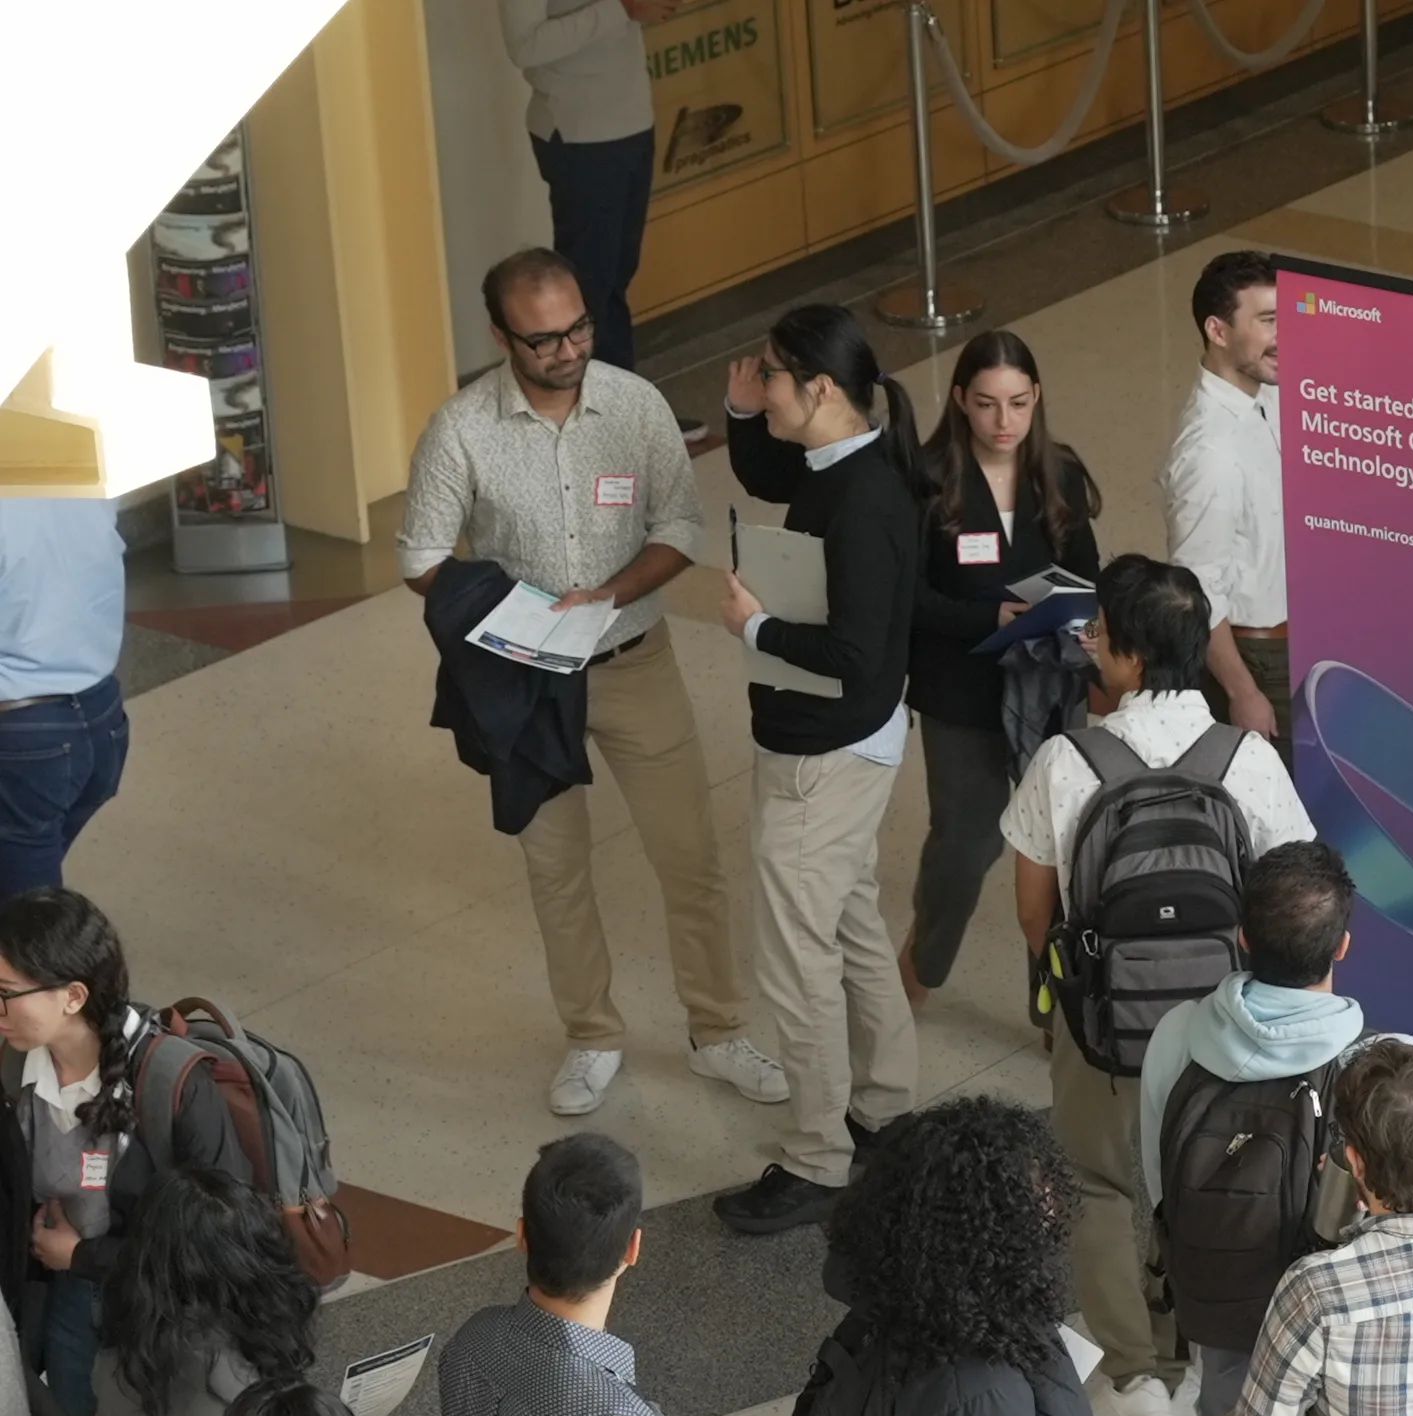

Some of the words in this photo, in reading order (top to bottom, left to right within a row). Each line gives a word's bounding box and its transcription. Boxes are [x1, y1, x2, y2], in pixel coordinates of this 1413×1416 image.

[1318, 298, 1383, 324] Microsoft
[1299, 378, 1338, 405] Get
[1301, 410, 1403, 449] Microsoft
